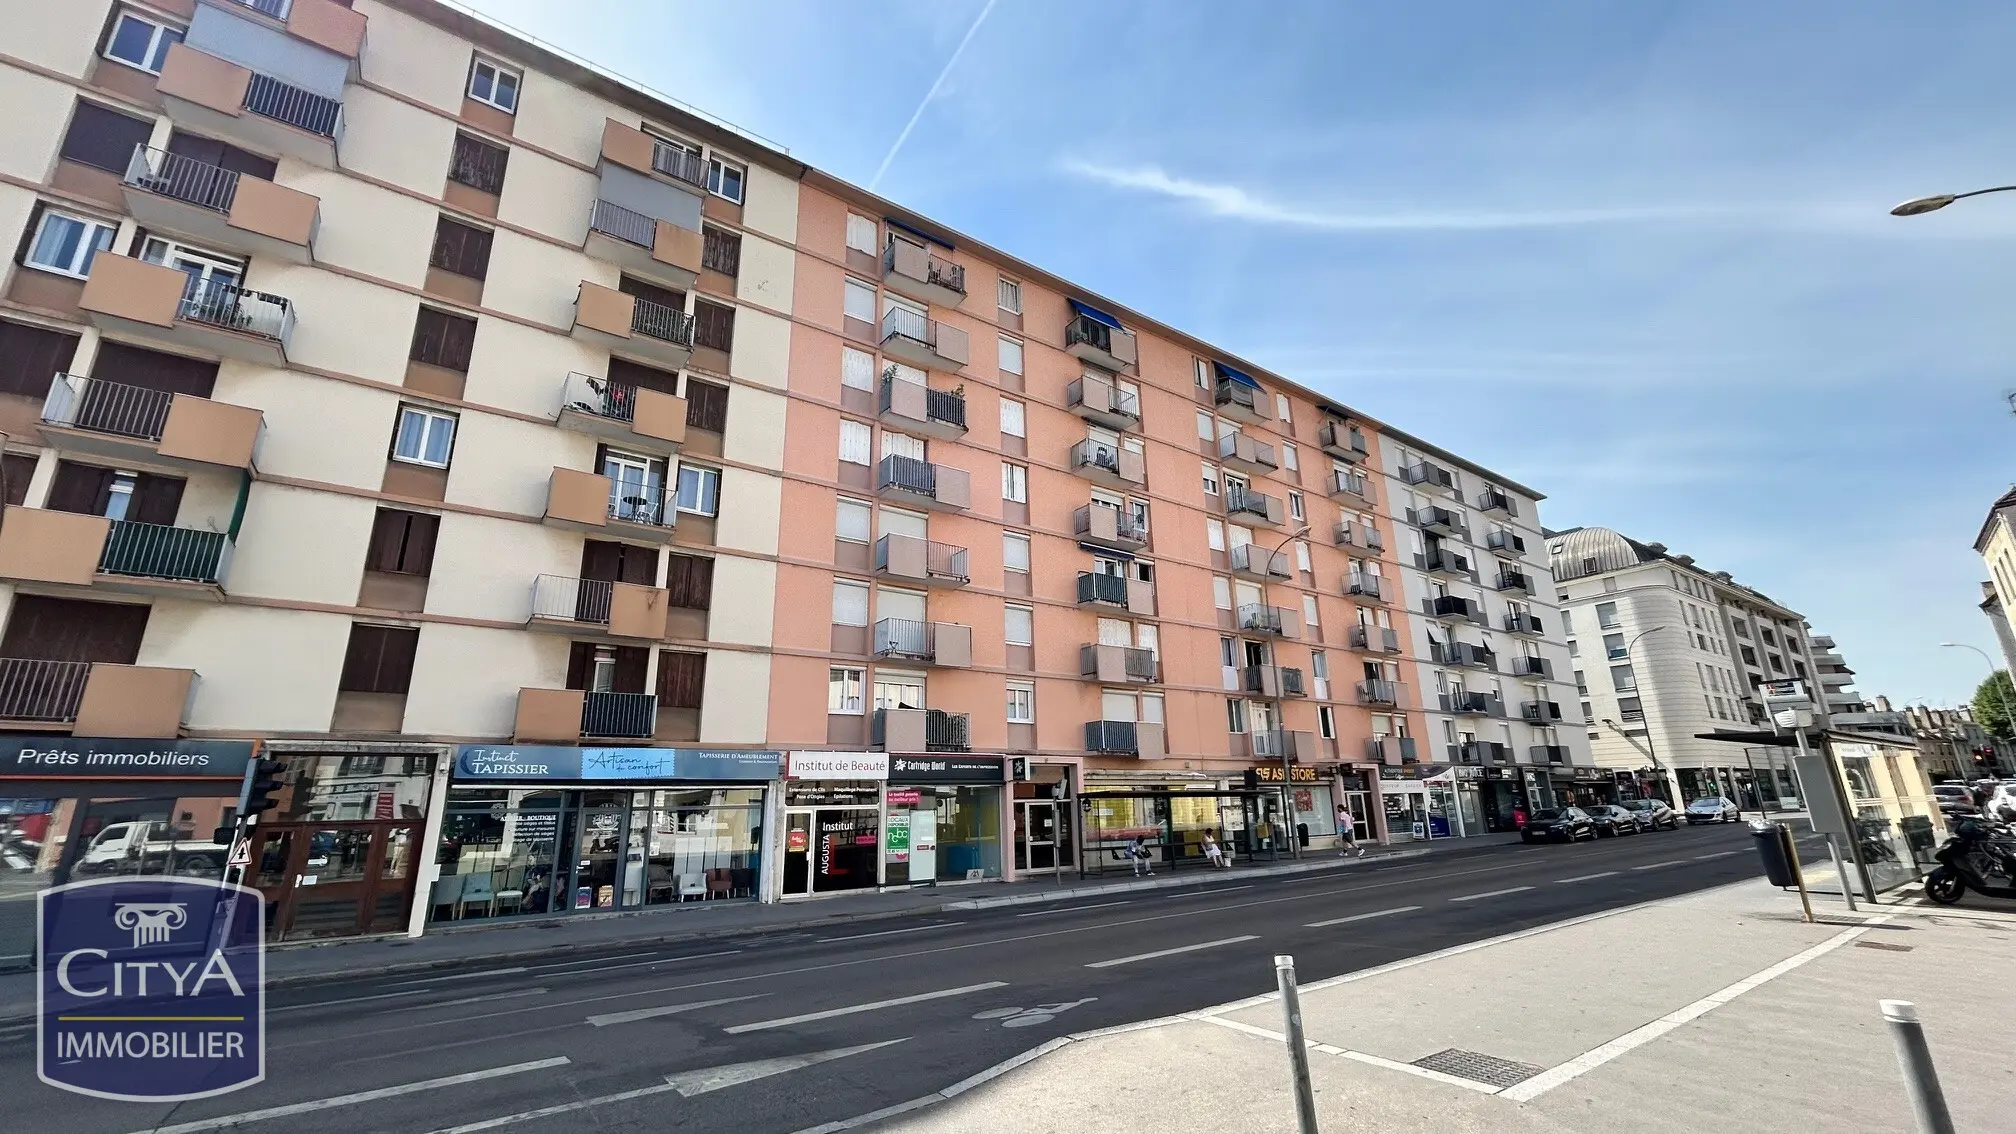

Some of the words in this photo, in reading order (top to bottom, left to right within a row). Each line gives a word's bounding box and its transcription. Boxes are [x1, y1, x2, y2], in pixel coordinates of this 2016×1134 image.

[17, 749, 80, 765] Prêts
[86, 750, 210, 766] immobiliers
[473, 749, 519, 762] Instinct
[588, 751, 641, 769] Artisan
[472, 762, 549, 775] TAPISSIER
[628, 757, 671, 776] confort
[795, 760, 833, 771] Institut
[835, 760, 848, 771] de
[851, 760, 886, 771] Beauté
[907, 761, 931, 772] Cartridge
[931, 761, 946, 771] World
[1272, 768, 1286, 780] ASI
[1291, 768, 1316, 781] STORE
[822, 821, 853, 831] Institut
[821, 834, 830, 875] AUGUSTA
